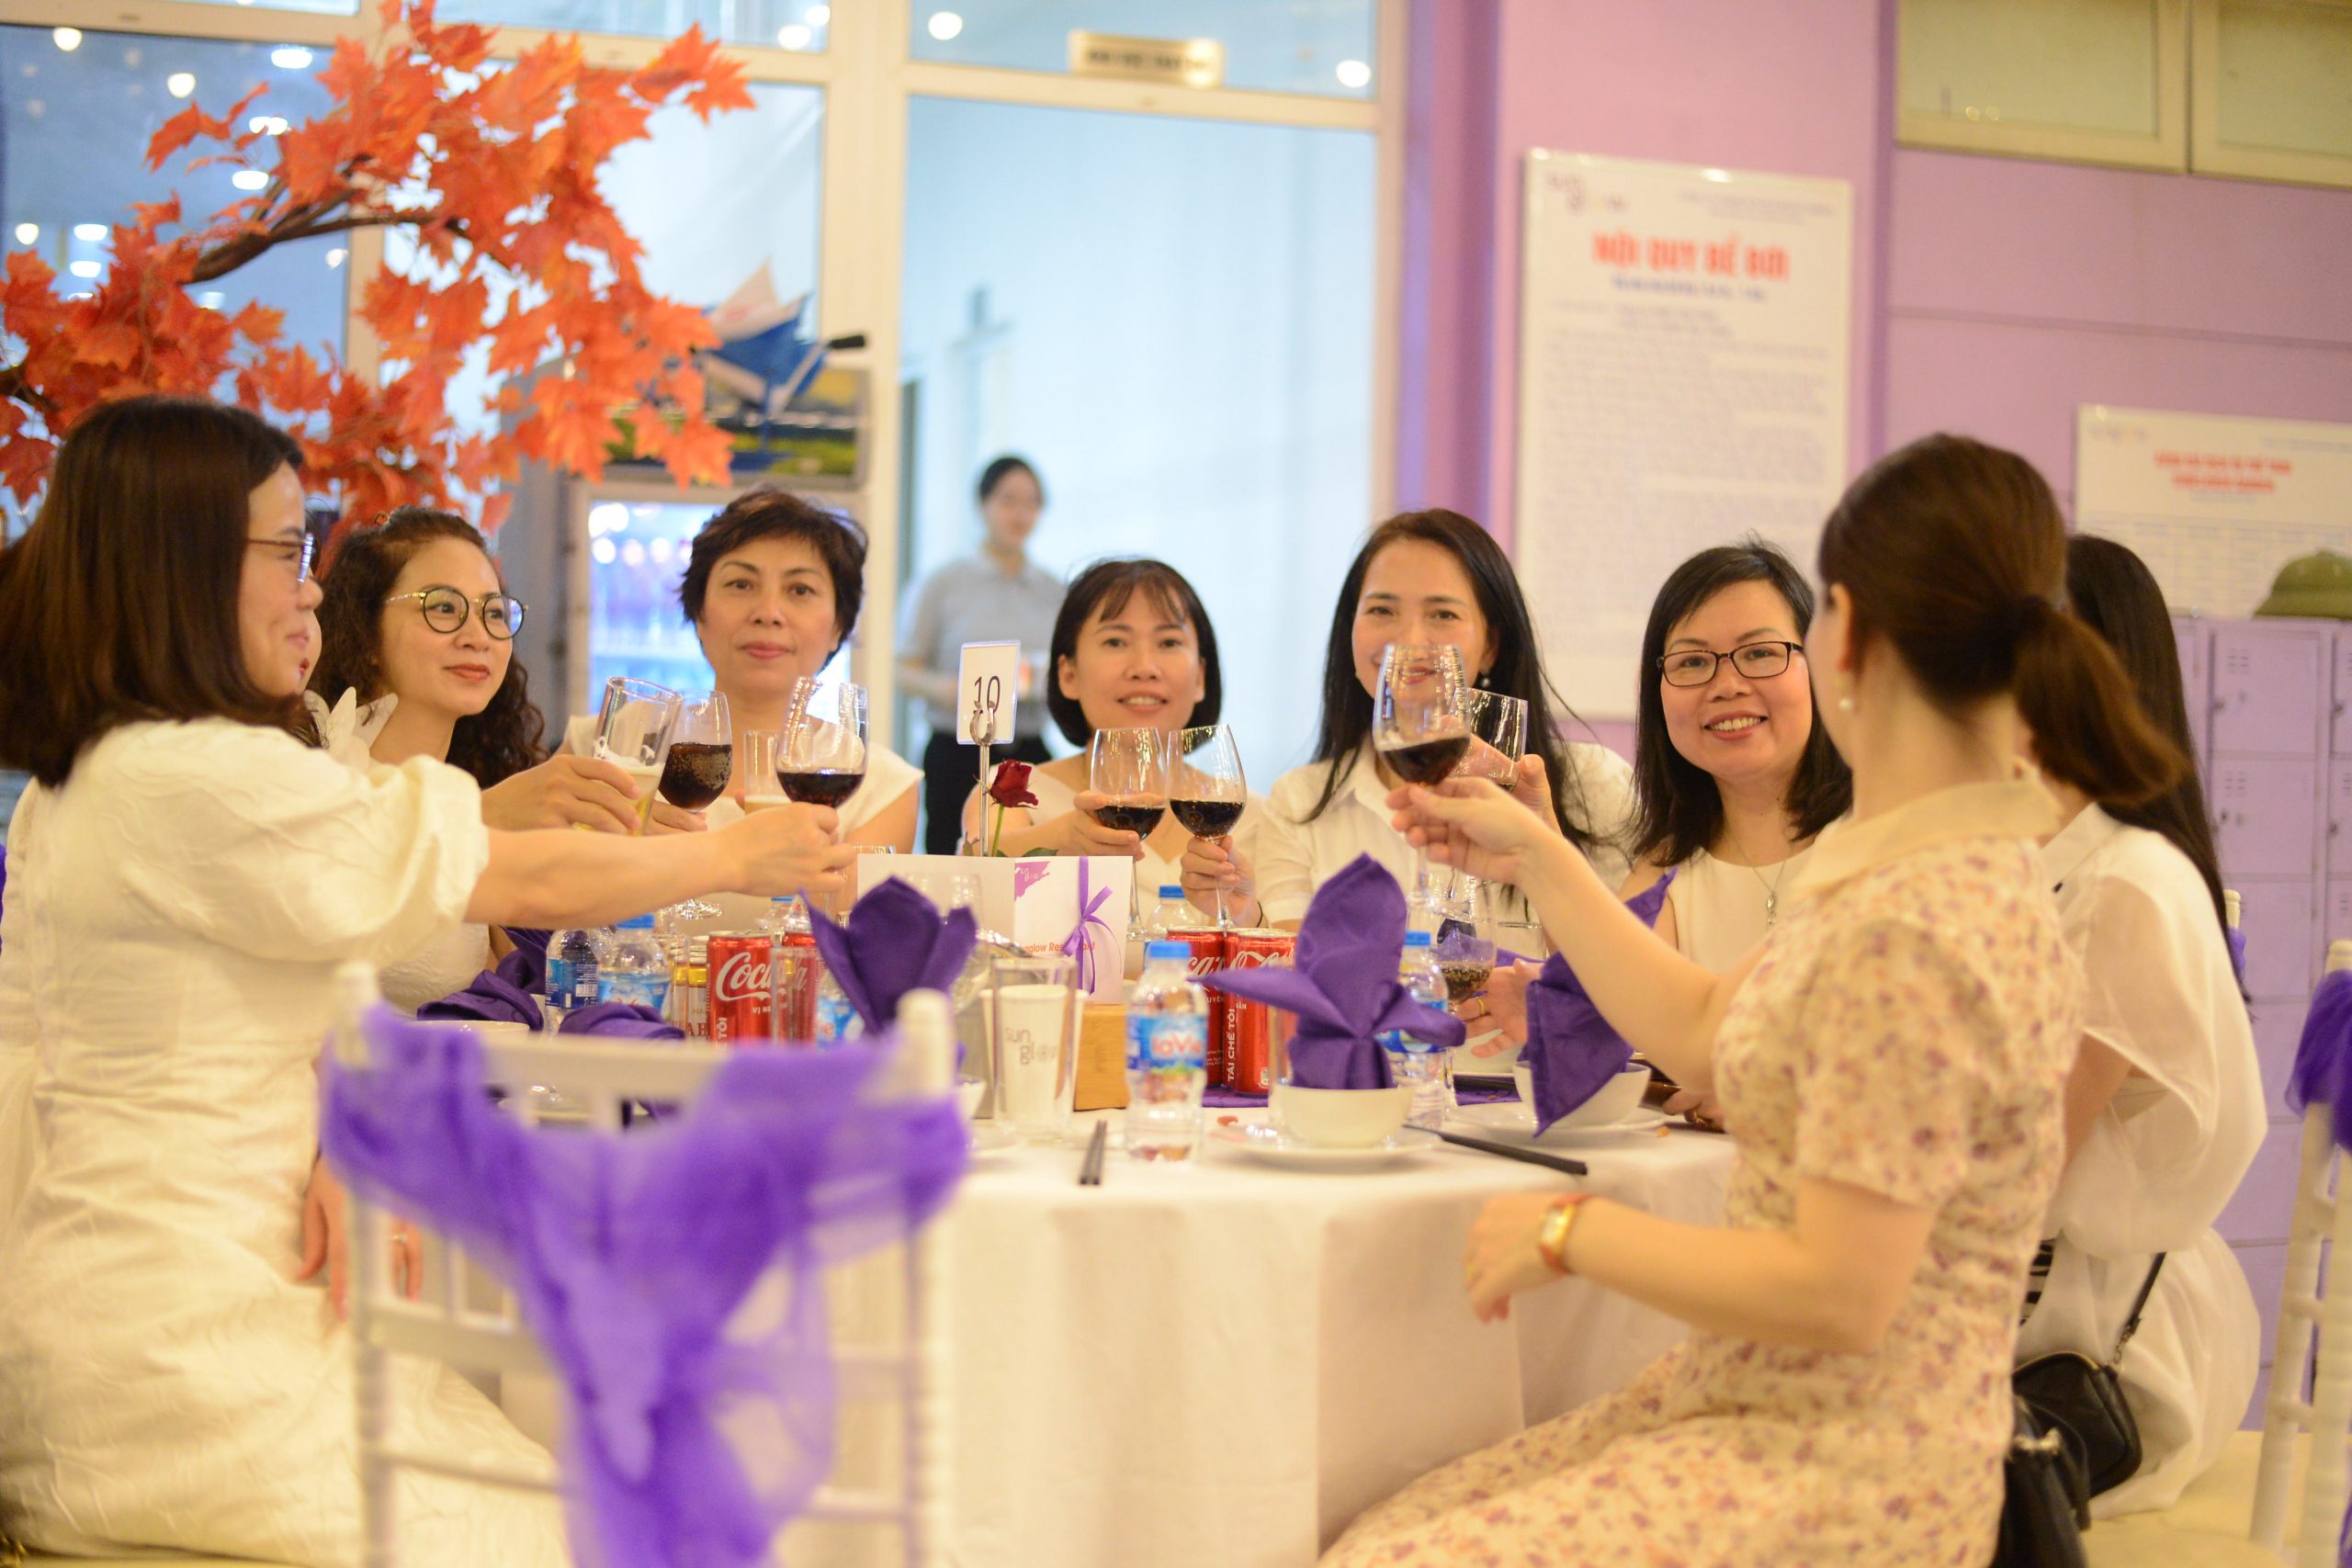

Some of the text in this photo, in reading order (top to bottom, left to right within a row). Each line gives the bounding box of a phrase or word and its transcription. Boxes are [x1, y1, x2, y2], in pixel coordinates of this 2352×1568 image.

[975, 676, 1001, 715] 10
[1023, 942, 1046, 955] nglow
[1227, 1009, 1236, 1029] TÔI
[1227, 1062, 1236, 1082] TÁI
